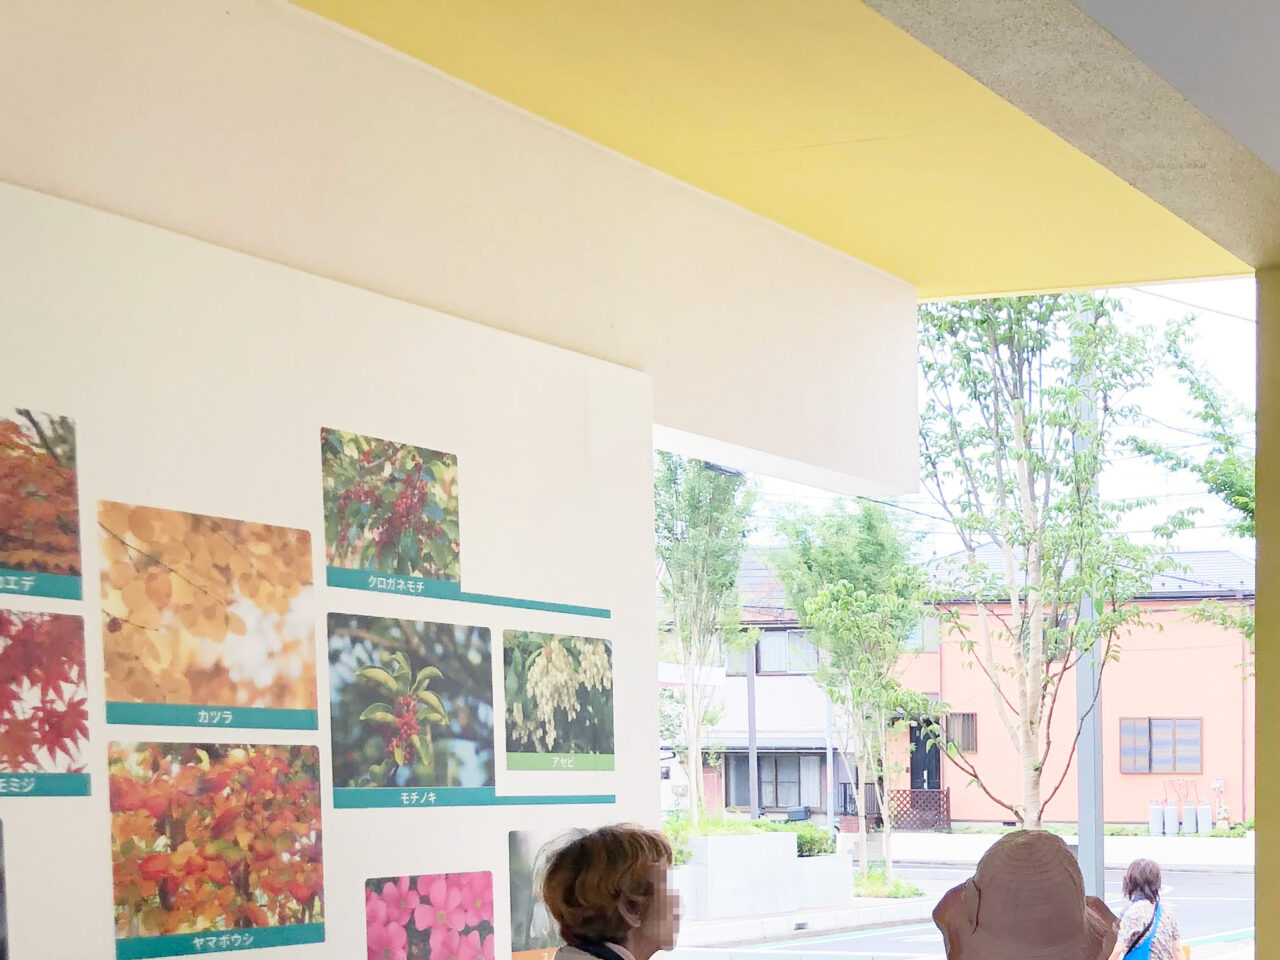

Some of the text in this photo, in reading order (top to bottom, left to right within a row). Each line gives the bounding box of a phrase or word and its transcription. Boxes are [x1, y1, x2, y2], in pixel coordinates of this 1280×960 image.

[367, 575, 425, 593] クロガネモチ
[198, 709, 233, 724] カツラ
[551, 756, 575, 768] アセビ
[400, 791, 437, 804] モチノキ
[193, 933, 255, 950] ヤマボウシ
